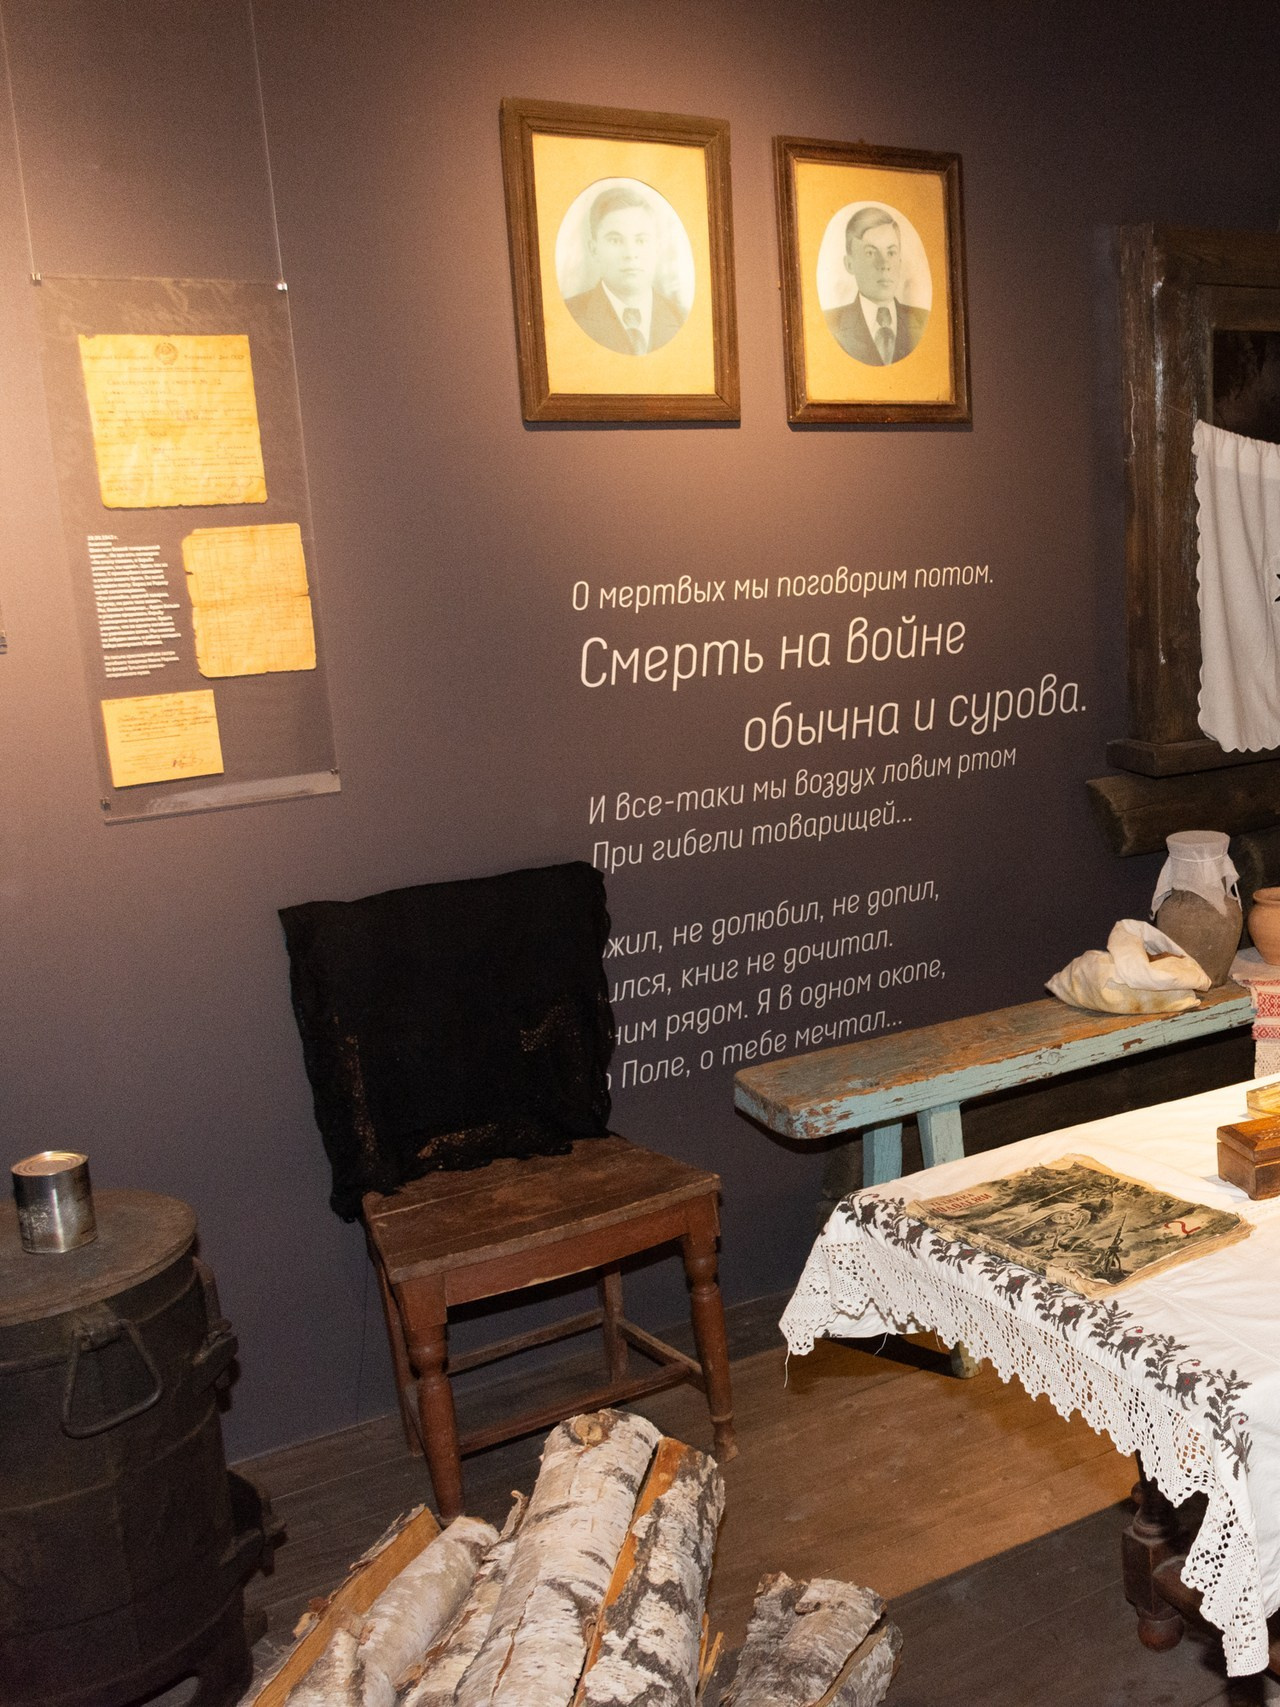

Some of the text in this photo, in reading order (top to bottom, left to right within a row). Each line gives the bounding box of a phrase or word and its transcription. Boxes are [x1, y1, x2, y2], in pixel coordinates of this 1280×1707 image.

[572, 565, 993, 614] О мертвых мы поговорим потом.
[580, 614, 966, 692] Смерть на войне
[744, 673, 1086, 752] обычна и сурова.
[589, 747, 1016, 825] И все-таки мы воздух ловим ртом
[592, 800, 912, 875] При гибели товарищей...
[673, 922, 703, 946] не
[712, 900, 824, 945] долюбил,
[832, 894, 860, 917] не
[867, 880, 939, 916] допил,
[681, 959, 739, 989] книг
[747, 952, 776, 975] не
[783, 929, 893, 974] дочитал.
[665, 1000, 748, 1042] рядом.
[757, 987, 771, 1015] Я
[779, 983, 792, 1010] в
[800, 973, 871, 1009] одном
[878, 959, 945, 989] окопе,
[621, 1056, 690, 1089] Поле,
[700, 1050, 714, 1070] о
[722, 1029, 787, 1065] тебе
[795, 1010, 903, 1048] мечтал...
[1164, 1220, 1201, 1235] 2
